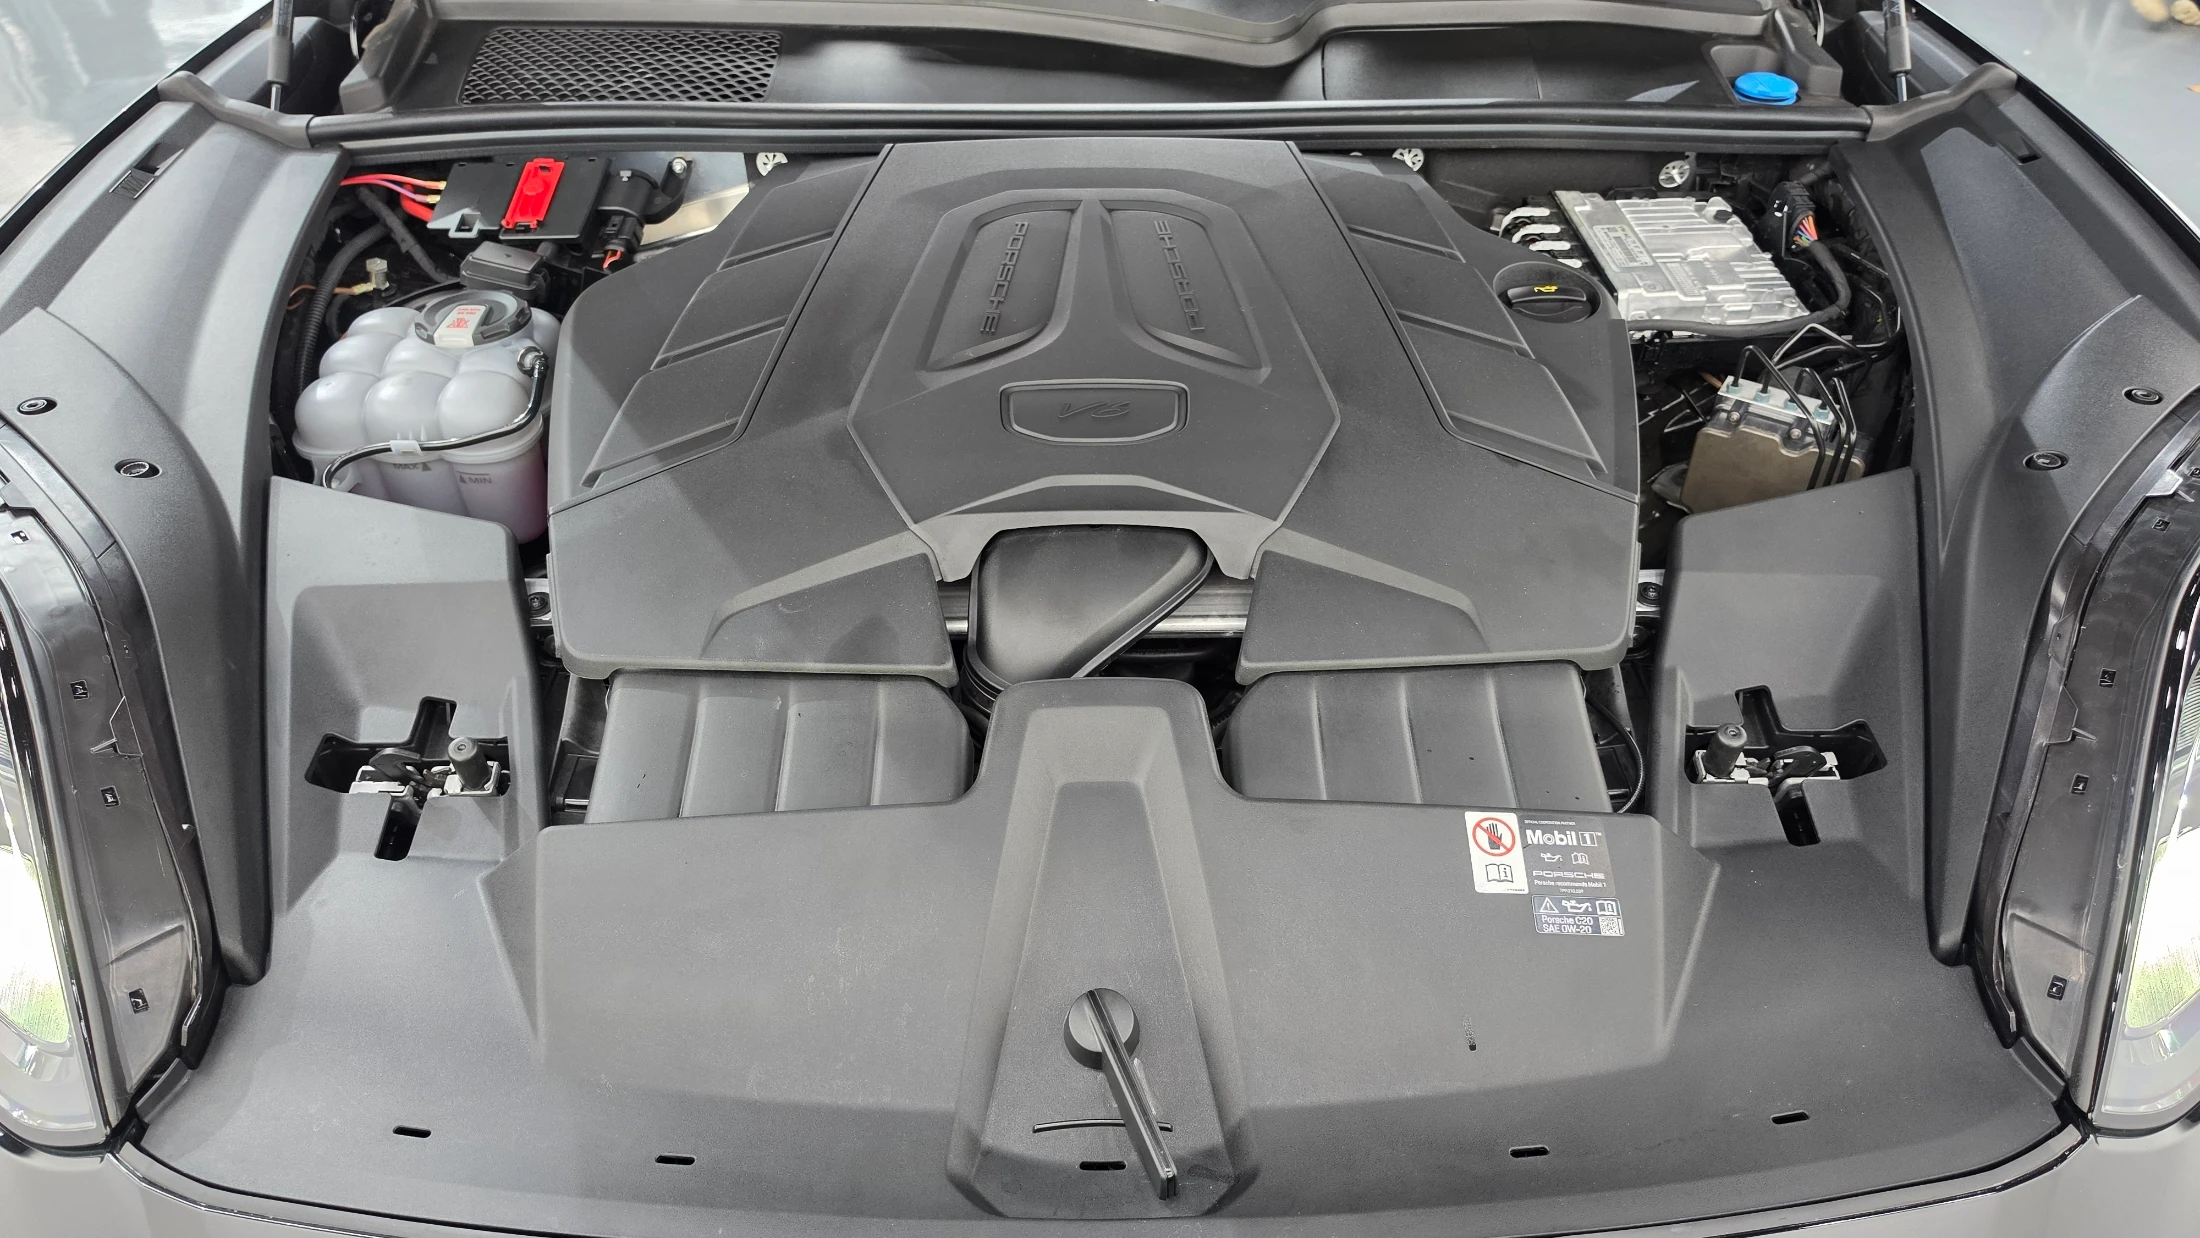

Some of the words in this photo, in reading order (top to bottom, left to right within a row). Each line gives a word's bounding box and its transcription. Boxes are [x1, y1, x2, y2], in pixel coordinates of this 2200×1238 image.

[980, 220, 1029, 333] PORSCHE
[1154, 219, 1206, 332] PORSCHE
[1057, 401, 1130, 419] V6
[468, 476, 493, 484] MIN
[1525, 829, 1578, 846] Mobil
[1532, 870, 1606, 880] PORSCHE
[1541, 914, 1575, 924] Porsche
[1575, 916, 1593, 926] C20
[1543, 923, 1561, 933] SAE
